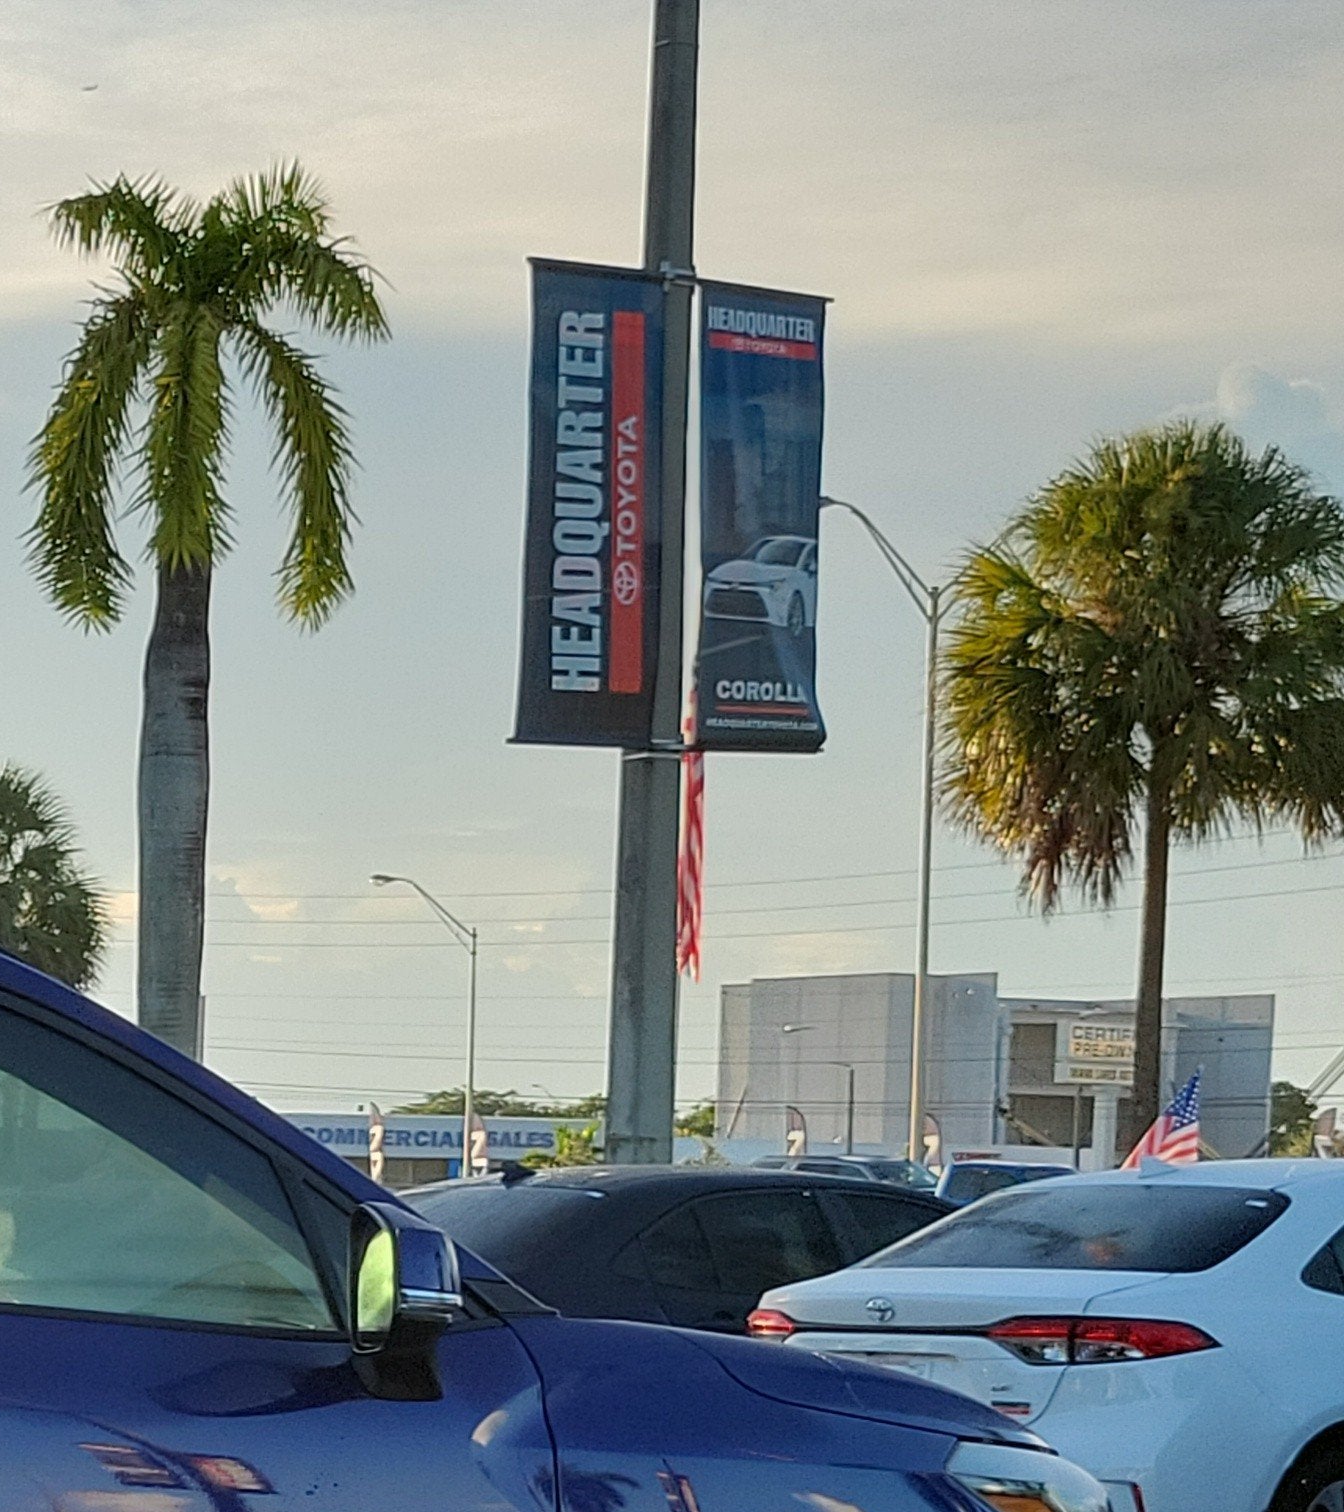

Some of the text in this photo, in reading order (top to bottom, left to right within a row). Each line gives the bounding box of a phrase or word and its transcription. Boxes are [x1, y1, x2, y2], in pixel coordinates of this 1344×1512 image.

[708, 305, 815, 342] HEADQUARTER
[617, 415, 638, 557] TOYOTA
[551, 311, 610, 692] HEADQUARTER
[716, 680, 809, 703] COROLLA
[1073, 1026, 1132, 1041] CERTIF
[487, 1131, 555, 1149] SALES
